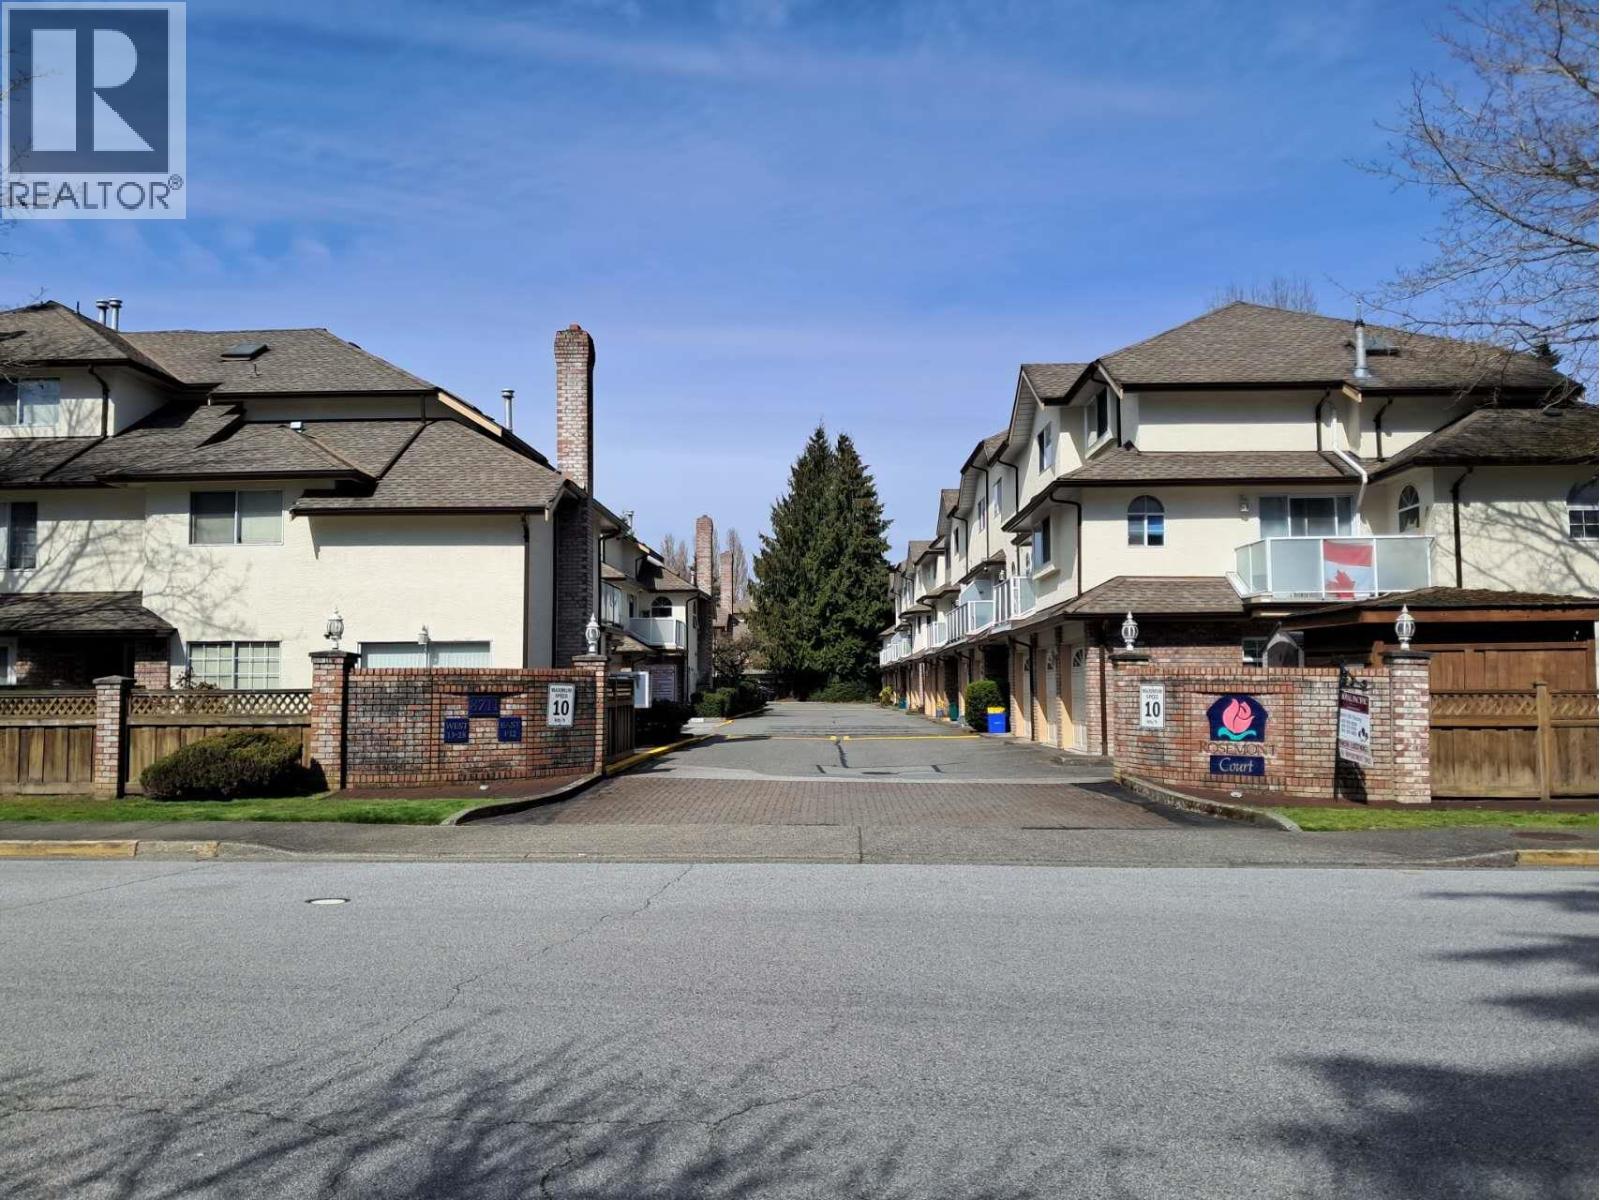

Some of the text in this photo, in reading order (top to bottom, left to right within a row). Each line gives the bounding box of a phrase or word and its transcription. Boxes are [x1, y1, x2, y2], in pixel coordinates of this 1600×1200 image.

[553, 700, 570, 716] 10
[1145, 701, 1161, 718] 10
[1200, 741, 1276, 756] ROSEMONT
[1219, 757, 1254, 773] Court
